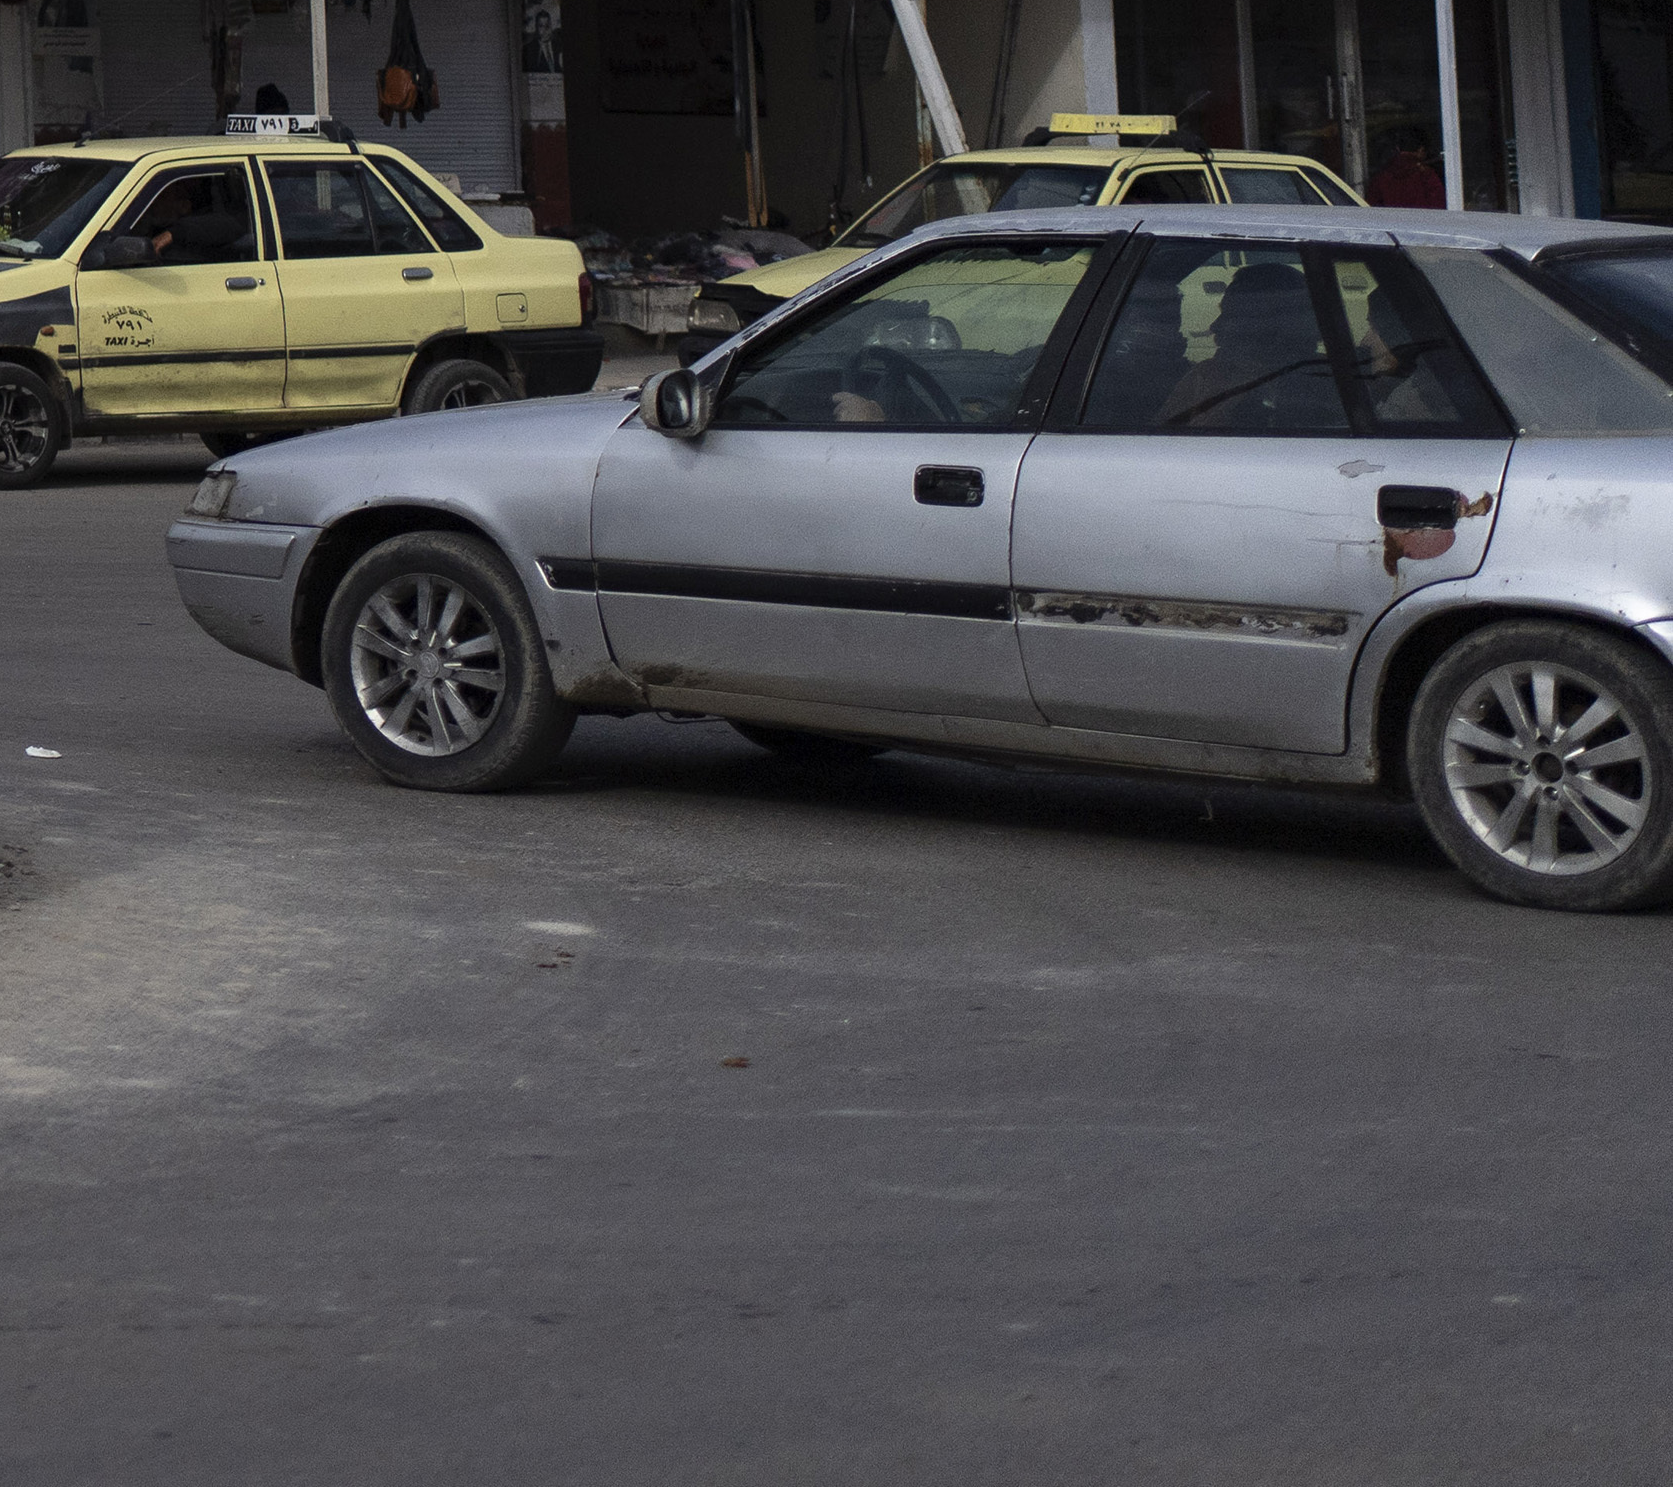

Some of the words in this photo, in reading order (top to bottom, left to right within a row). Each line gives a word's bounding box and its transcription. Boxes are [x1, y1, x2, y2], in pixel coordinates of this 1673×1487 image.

[229, 119, 255, 131] TAXI
[261, 118, 283, 130] ٧٩١
[116, 320, 142, 330] ٧٩١
[105, 337, 128, 345] TAXI
[130, 334, 154, 347] أجرة
